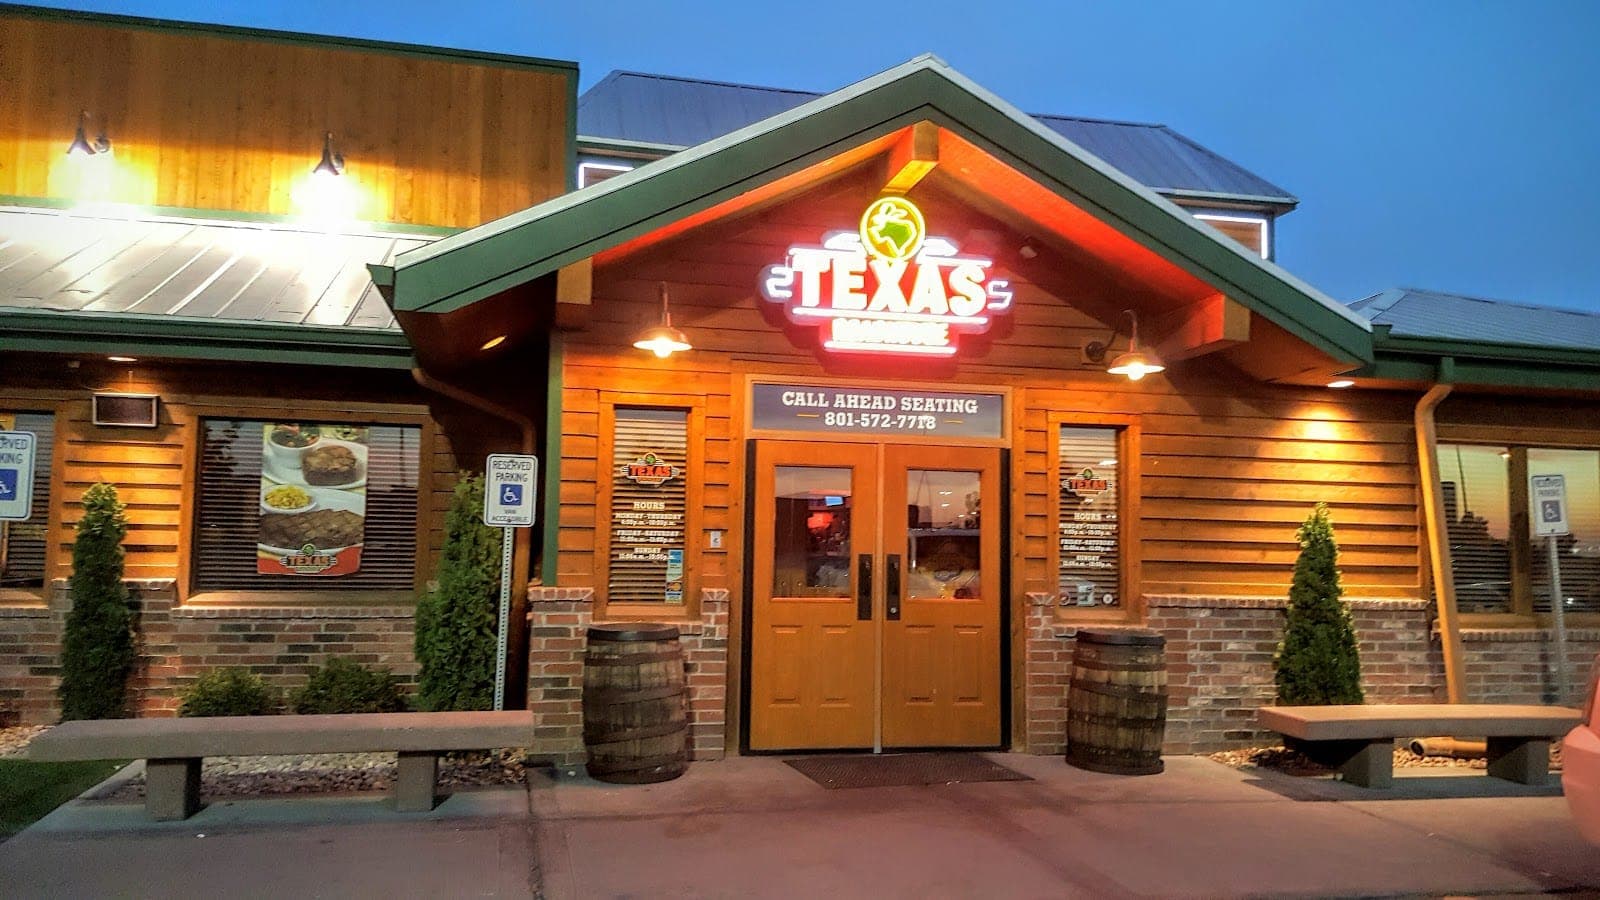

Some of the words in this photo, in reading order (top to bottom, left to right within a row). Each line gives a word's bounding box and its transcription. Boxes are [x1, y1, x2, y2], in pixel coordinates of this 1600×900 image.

[792, 251, 987, 317] TEXAS
[782, 391, 829, 408] CALL
[833, 394, 896, 410] AHEAD
[901, 397, 978, 414] SEATING
[493, 460, 531, 471] RESERVED
[630, 465, 671, 476] TEXAS
[495, 472, 529, 482] PARKING
[1070, 479, 1106, 490] TEXAS
[633, 501, 666, 510] HOURS
[1073, 512, 1102, 520] HOURS
[288, 556, 330, 566] TEXAS
